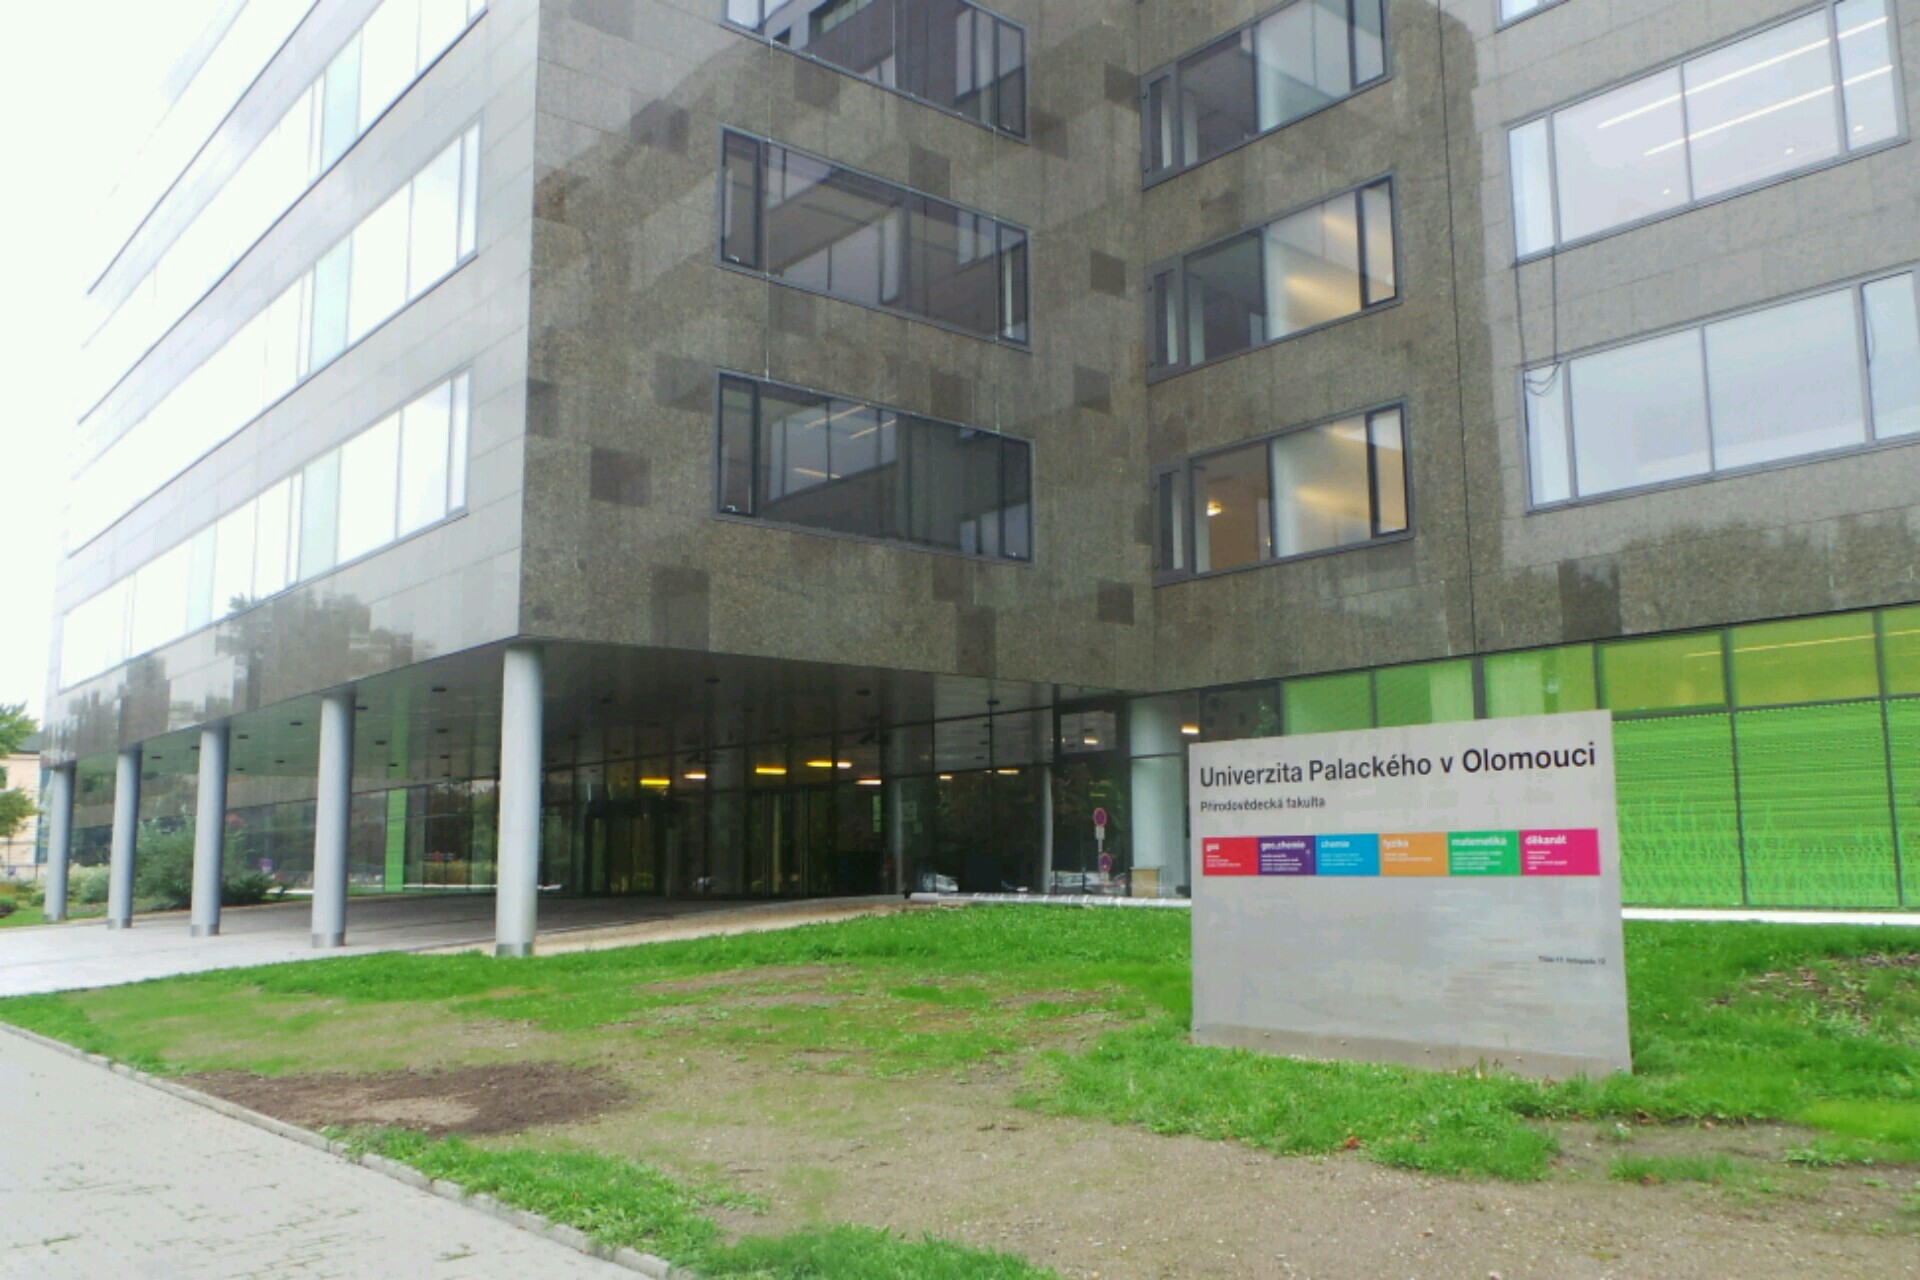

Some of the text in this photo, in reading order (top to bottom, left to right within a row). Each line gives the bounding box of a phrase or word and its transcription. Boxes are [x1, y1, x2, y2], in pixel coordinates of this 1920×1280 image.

[1200, 741, 1595, 787] Univerzita Palackého v Olomouci
[1286, 795, 1326, 809] fakulta
[1525, 834, 1567, 846] děkanát
